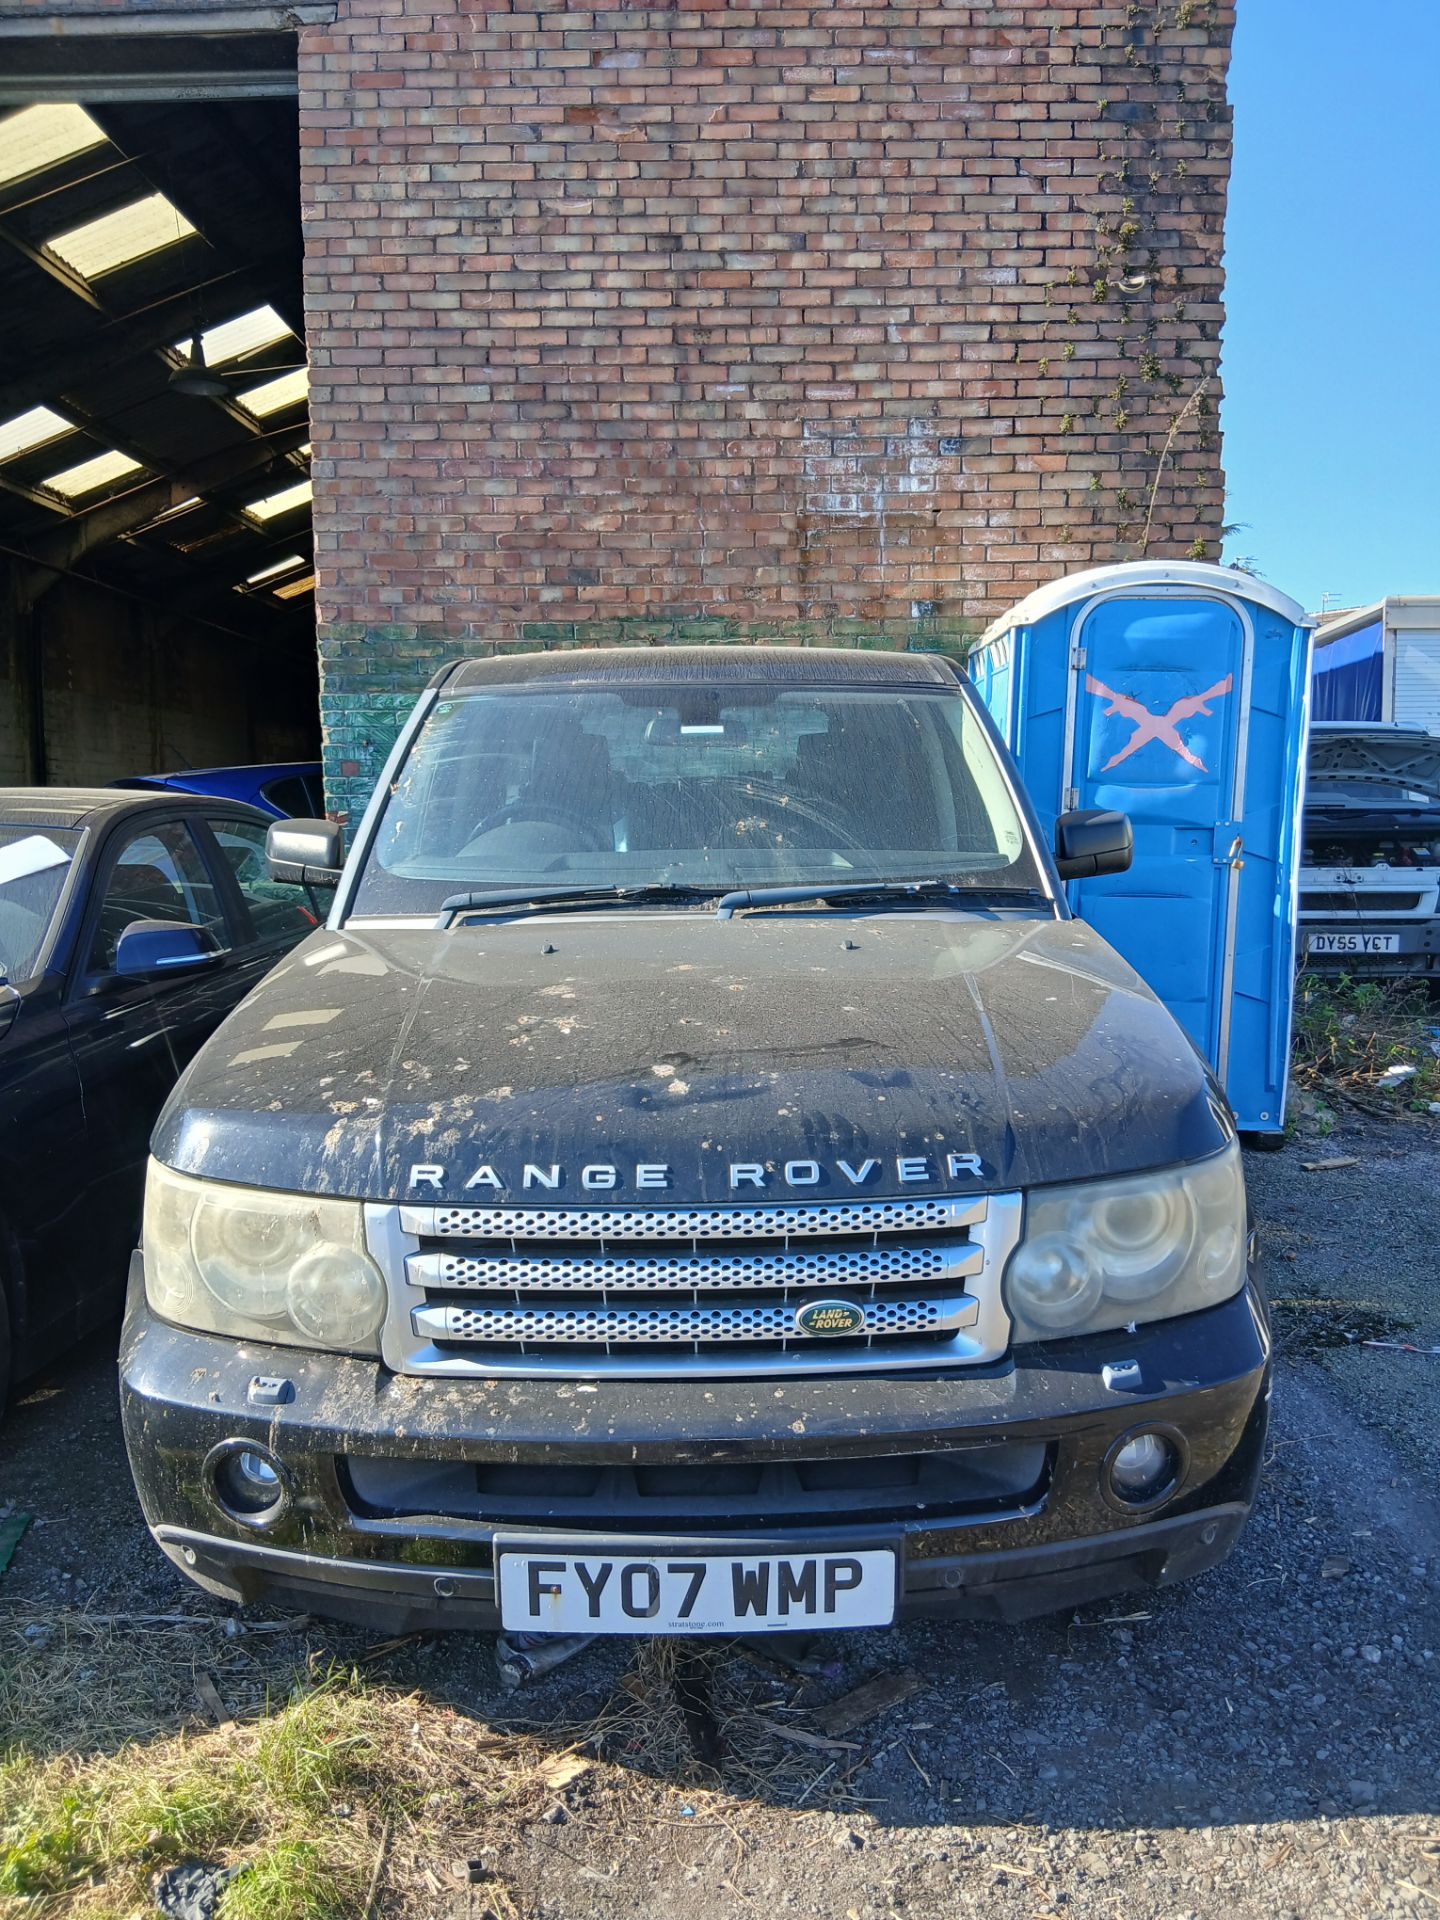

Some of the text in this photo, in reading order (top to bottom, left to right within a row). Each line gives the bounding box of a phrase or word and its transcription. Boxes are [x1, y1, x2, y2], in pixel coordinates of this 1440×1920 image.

[1316, 936, 1392, 950] DY55 YCT
[409, 1153, 985, 1190] RANGE ROVER
[812, 1309, 842, 1319] LAND
[815, 1319, 852, 1328] ROVER
[527, 1557, 863, 1619] FY07 WMP
[667, 1620, 725, 1629] stratstone.com
